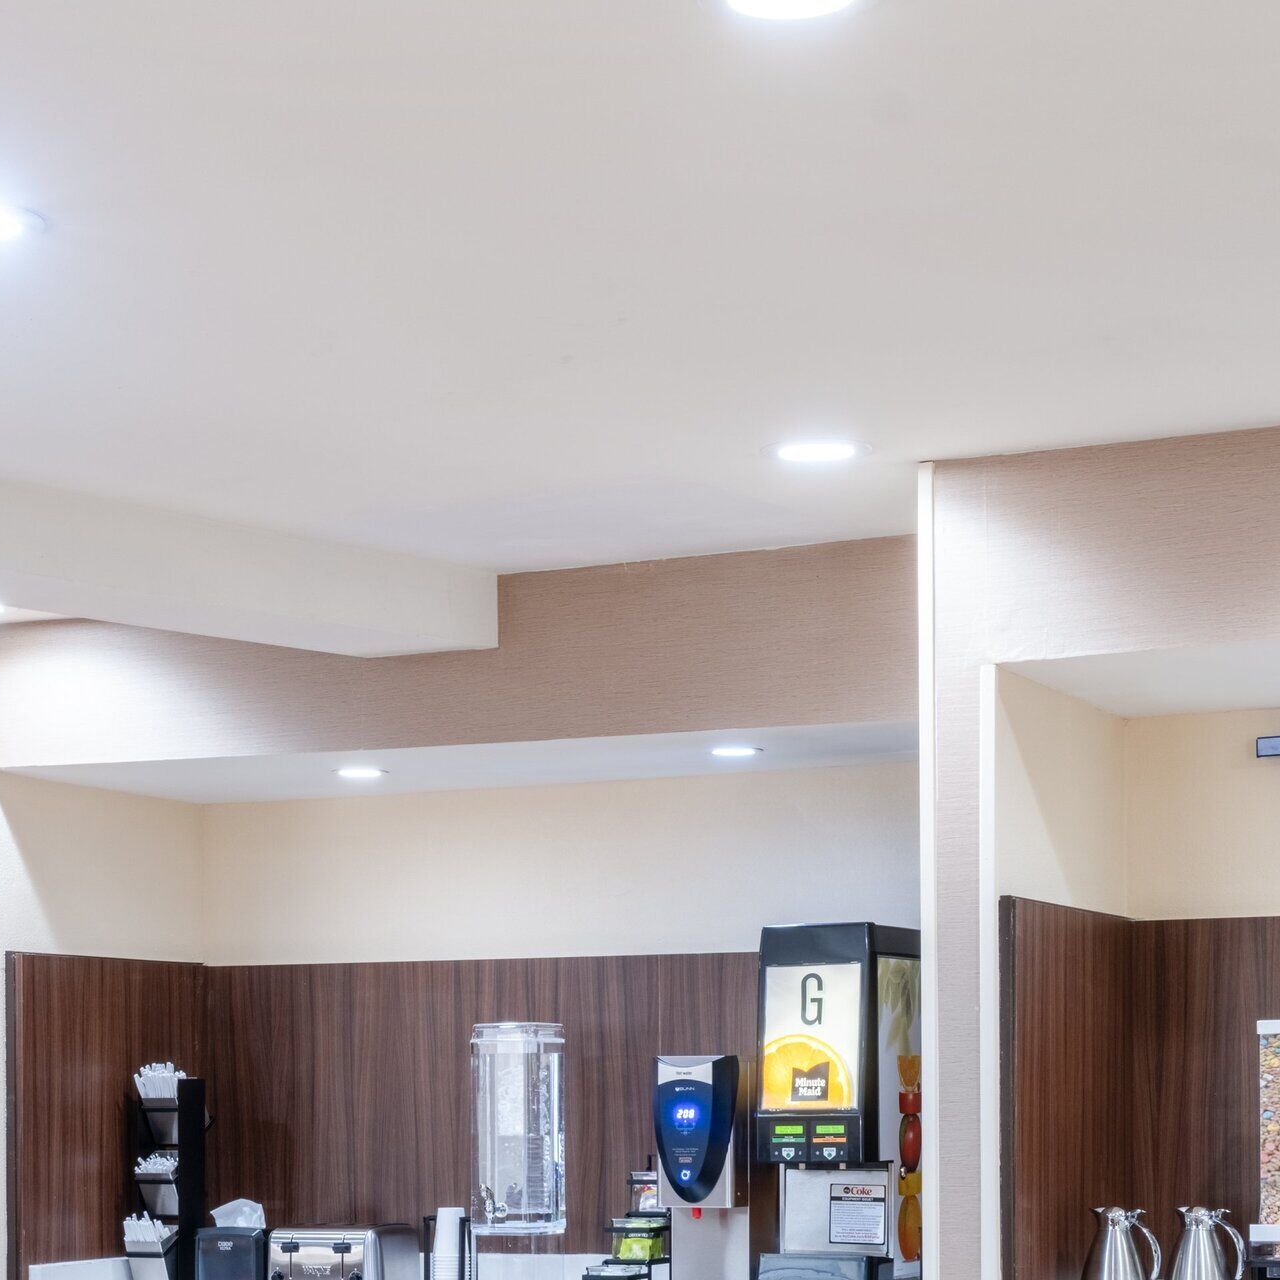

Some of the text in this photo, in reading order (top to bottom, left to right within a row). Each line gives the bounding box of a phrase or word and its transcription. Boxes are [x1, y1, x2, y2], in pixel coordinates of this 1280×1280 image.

[800, 972, 824, 1026] G
[795, 1077, 826, 1087] Minute
[798, 1086, 823, 1096] Maid
[676, 1108, 695, 1119] 208
[850, 1186, 872, 1196] Coke
